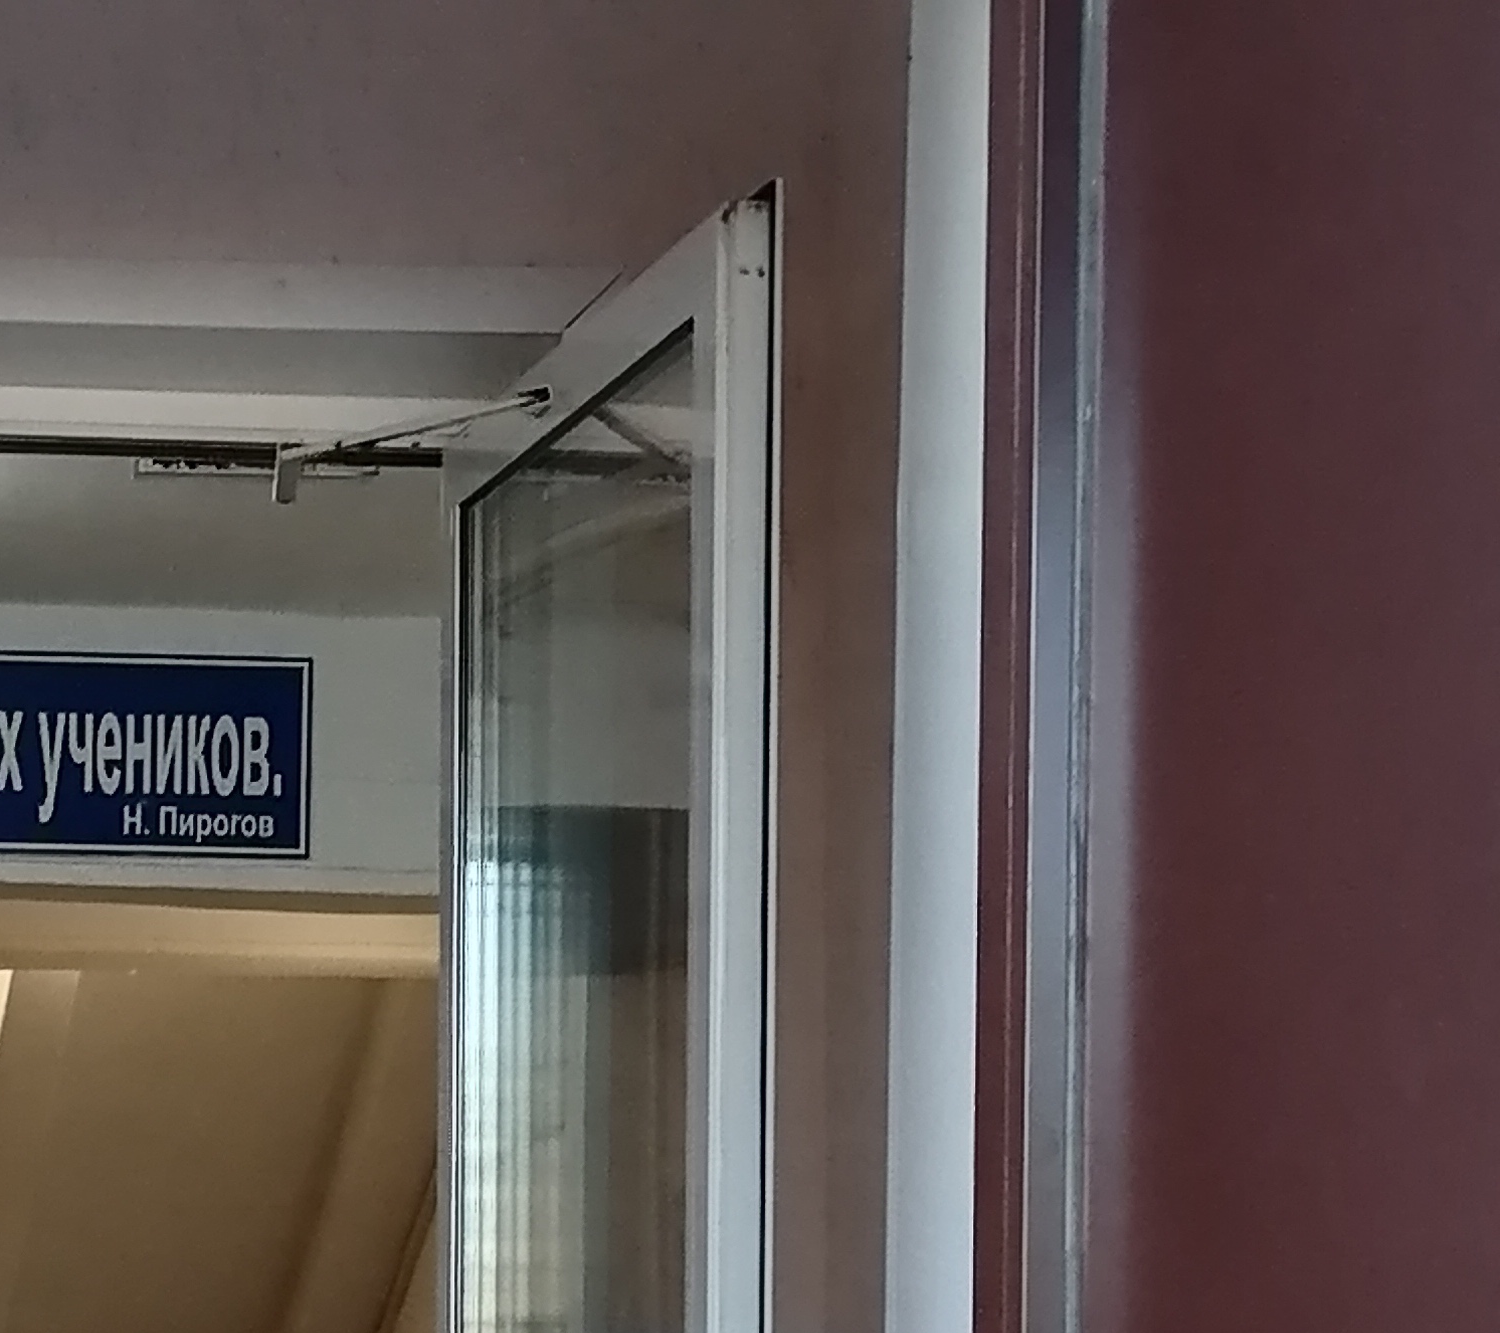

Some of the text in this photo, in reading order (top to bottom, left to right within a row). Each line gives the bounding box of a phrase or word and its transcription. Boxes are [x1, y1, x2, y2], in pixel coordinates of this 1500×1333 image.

[38, 712, 284, 823] учеников.
[122, 806, 276, 844] Н. Пирогов
